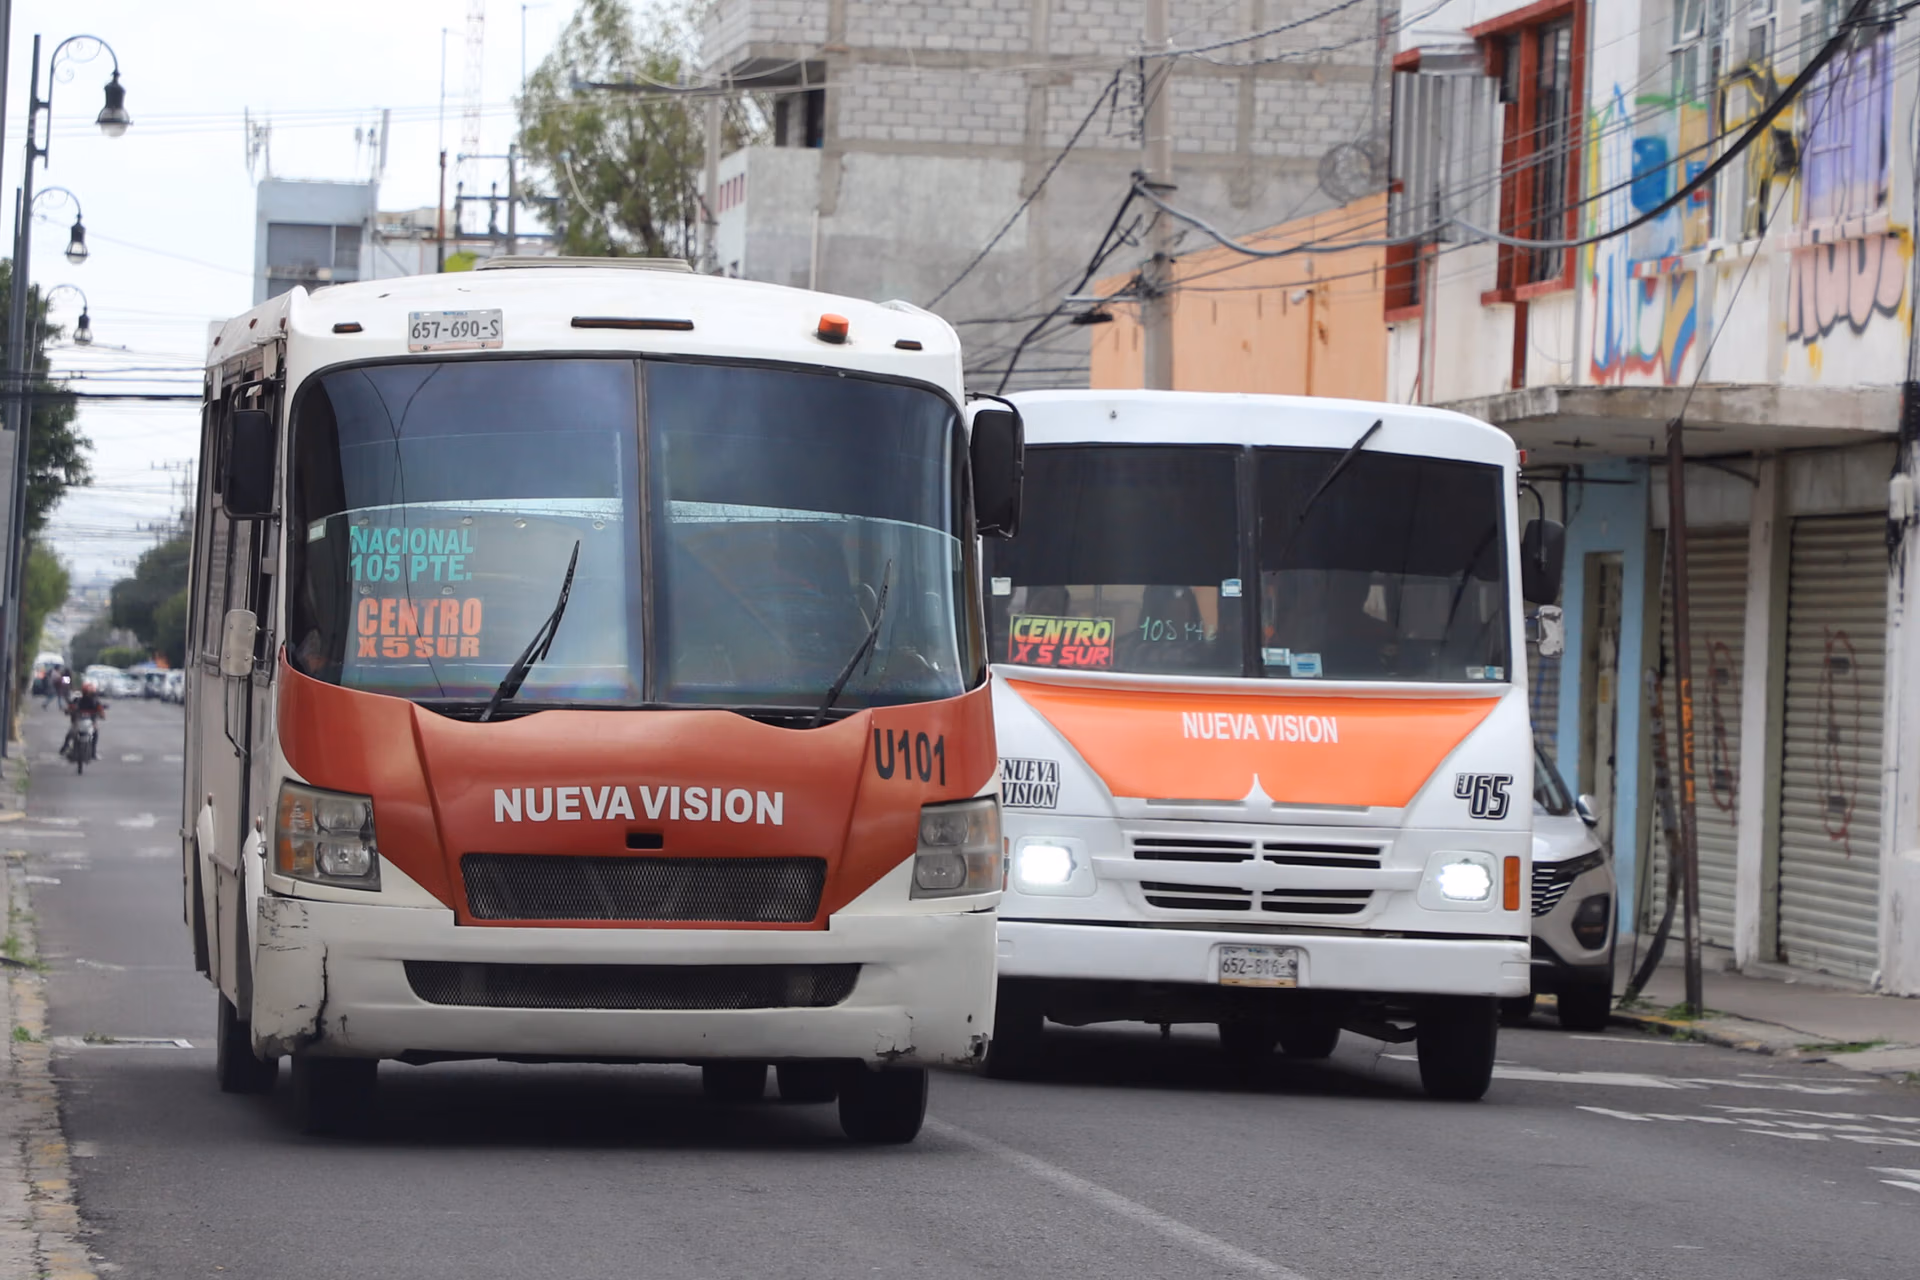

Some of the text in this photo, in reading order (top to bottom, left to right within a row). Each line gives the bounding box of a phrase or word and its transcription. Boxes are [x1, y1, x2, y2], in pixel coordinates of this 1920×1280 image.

[411, 318, 499, 339] 657-690-S
[350, 525, 474, 554] NACIONAL
[350, 554, 472, 582] 105 PTE.
[357, 597, 483, 636] CENTRO
[1014, 617, 1112, 646] CENTRO
[357, 636, 481, 659] X 5 SUR
[1013, 643, 1034, 663] X
[1058, 646, 1110, 666] SUR
[1182, 712, 1340, 744] NUEVA VISION
[873, 727, 946, 787] U101
[1002, 758, 1057, 783] NUEVA
[493, 785, 784, 826] NUEVA VISION
[1001, 781, 1057, 807] VISION
[1454, 773, 1514, 820] U65
